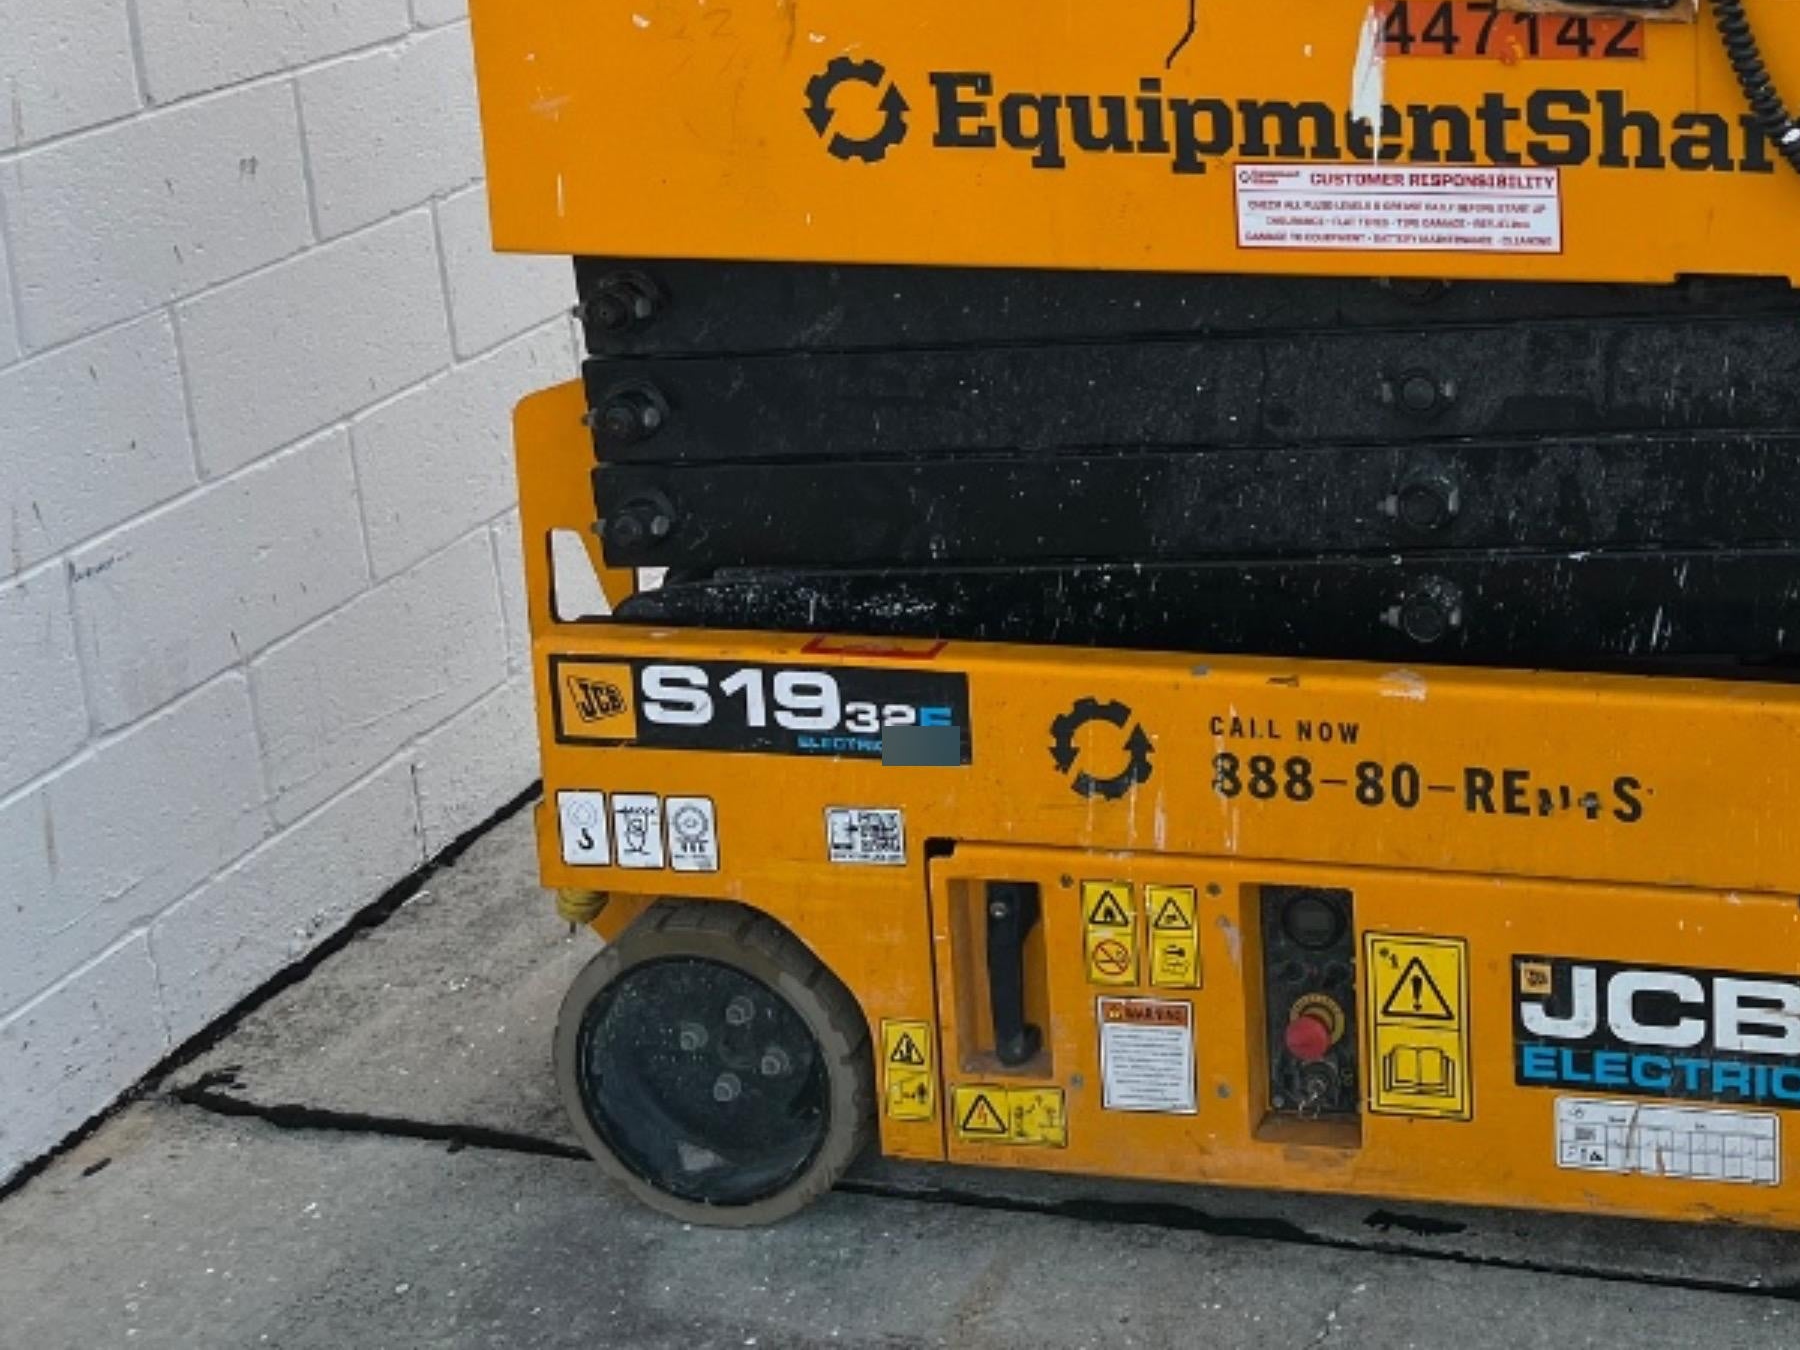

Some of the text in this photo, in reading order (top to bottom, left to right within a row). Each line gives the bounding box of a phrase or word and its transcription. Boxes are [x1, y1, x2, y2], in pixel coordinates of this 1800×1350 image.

[1383, 0, 1641, 57] 447142
[567, 674, 628, 722] JCB
[1210, 716, 1360, 744] CALL NOW
